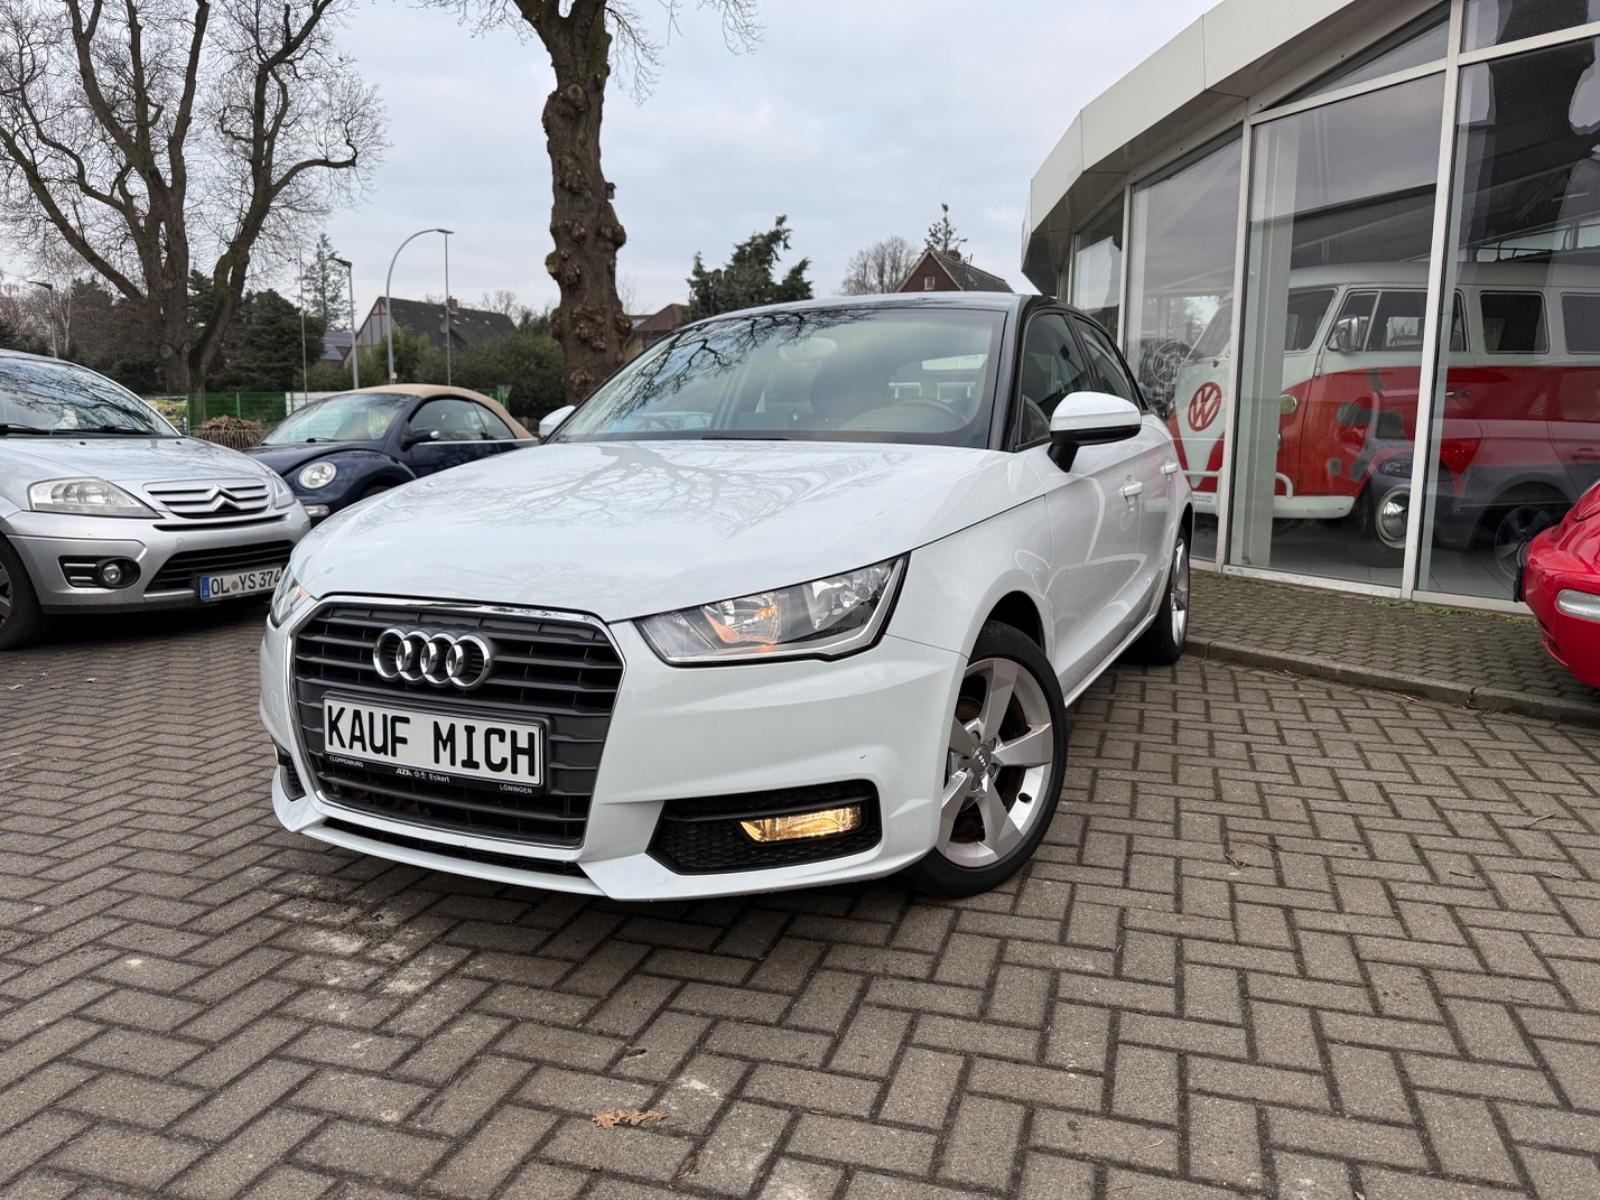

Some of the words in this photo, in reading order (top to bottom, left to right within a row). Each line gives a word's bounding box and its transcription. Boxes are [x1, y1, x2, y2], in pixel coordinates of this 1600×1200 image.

[1188, 382, 1221, 431] VW
[211, 577, 230, 595] OL
[238, 573, 256, 590] YS
[328, 705, 410, 757] KAUF
[433, 720, 536, 776] MICH
